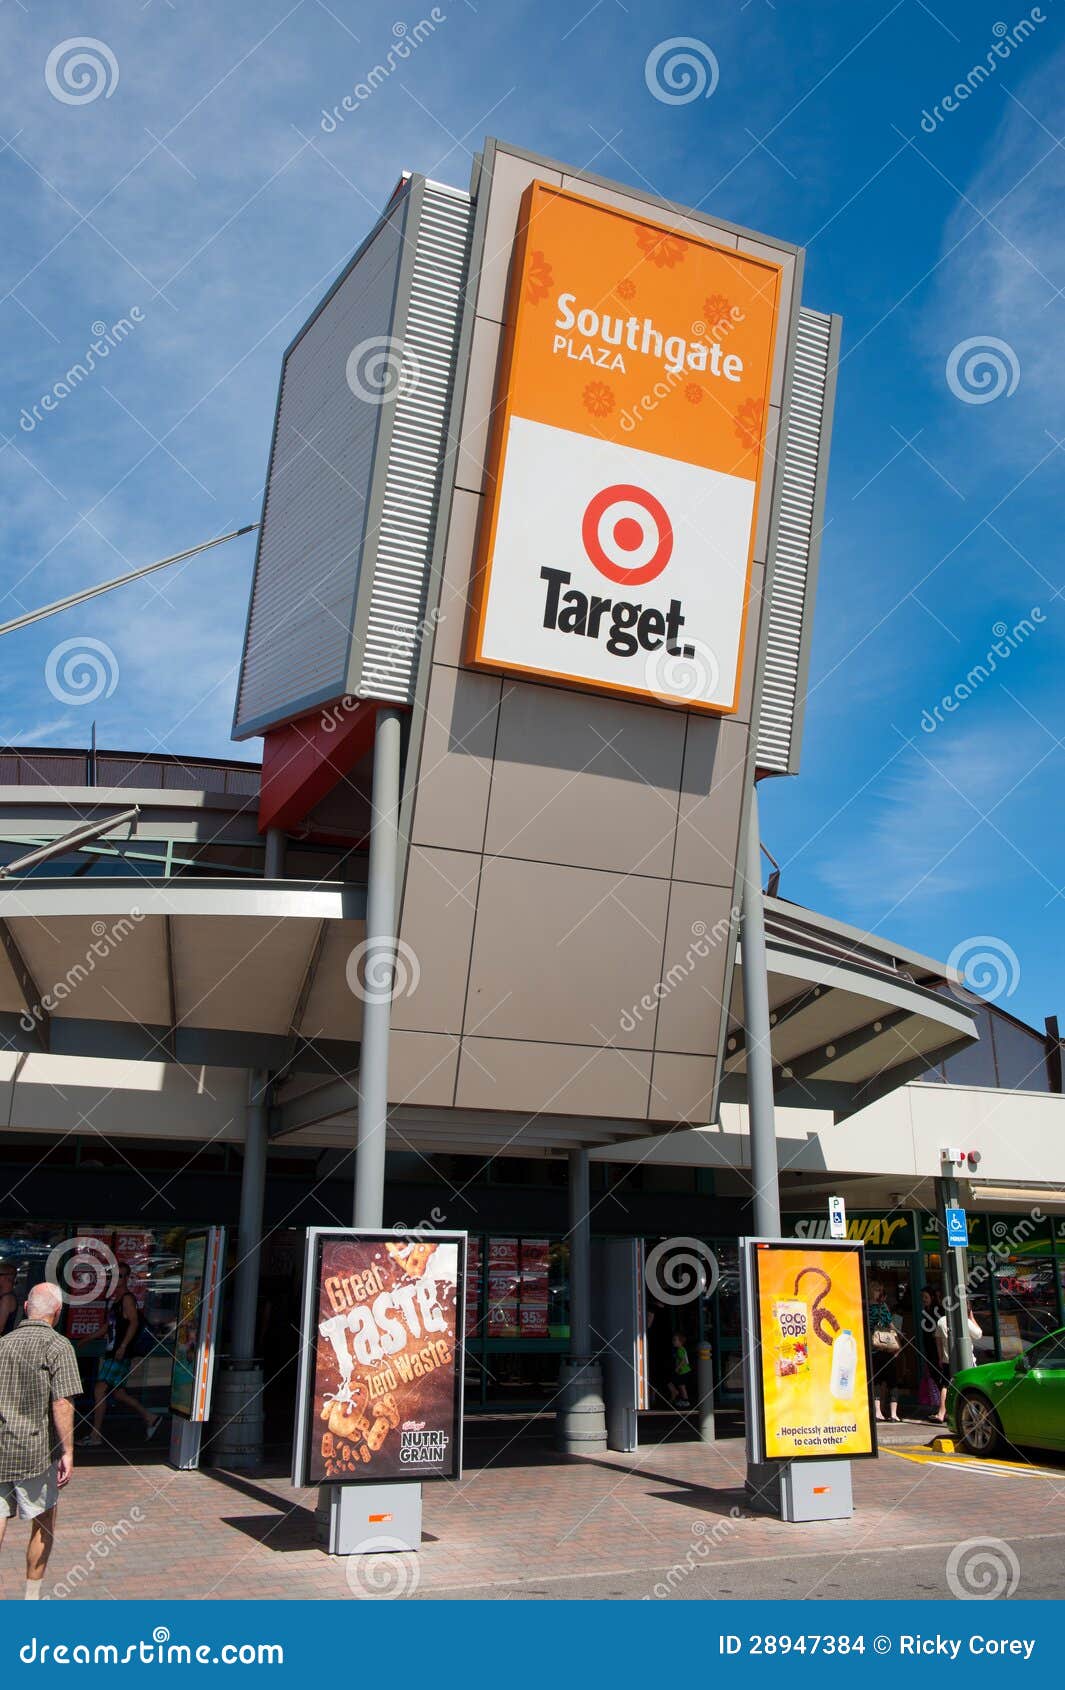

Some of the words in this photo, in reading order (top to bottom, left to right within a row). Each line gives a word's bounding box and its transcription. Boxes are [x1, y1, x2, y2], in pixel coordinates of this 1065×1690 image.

[554, 292, 744, 384] Southgate
[553, 335, 626, 375] PLAZA
[539, 565, 696, 659] Target.
[833, 1200, 839, 1209] P
[794, 1217, 908, 1245] SUWAY
[324, 1262, 385, 1313] Great
[393, 1339, 452, 1384] Waste
[401, 1430, 449, 1448] NUTRI-
[794, 1437, 802, 1446] to
[803, 1436, 822, 1445] each
[823, 1424, 857, 1434] attracted
[400, 1446, 444, 1463] GRAIN
